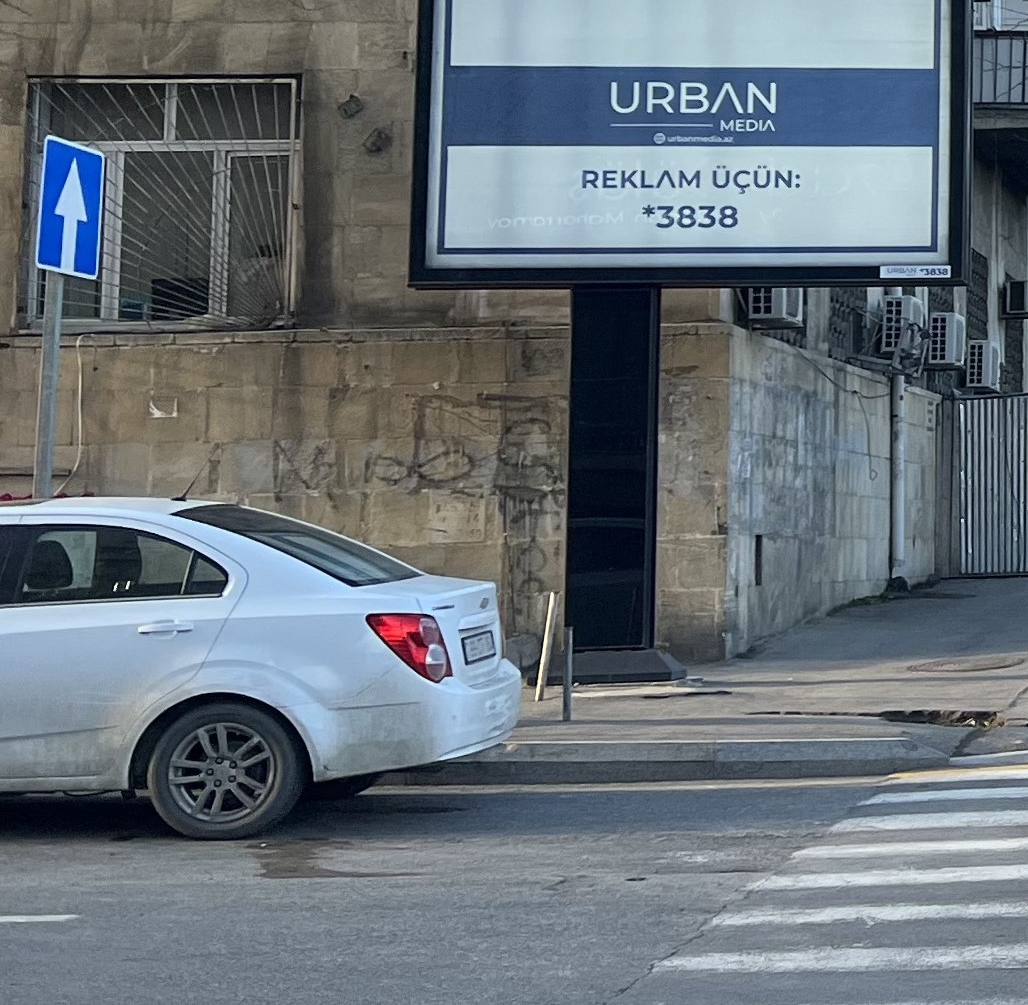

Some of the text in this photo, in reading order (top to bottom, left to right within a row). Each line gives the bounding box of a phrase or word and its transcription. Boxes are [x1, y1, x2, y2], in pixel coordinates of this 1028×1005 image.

[610, 81, 777, 114] URBAN
[719, 119, 776, 132] MEDIA
[666, 133, 734, 145] urbanmedia.az
[581, 169, 701, 189] REKLAM
[712, 165, 801, 194] ÜÇÜN:
